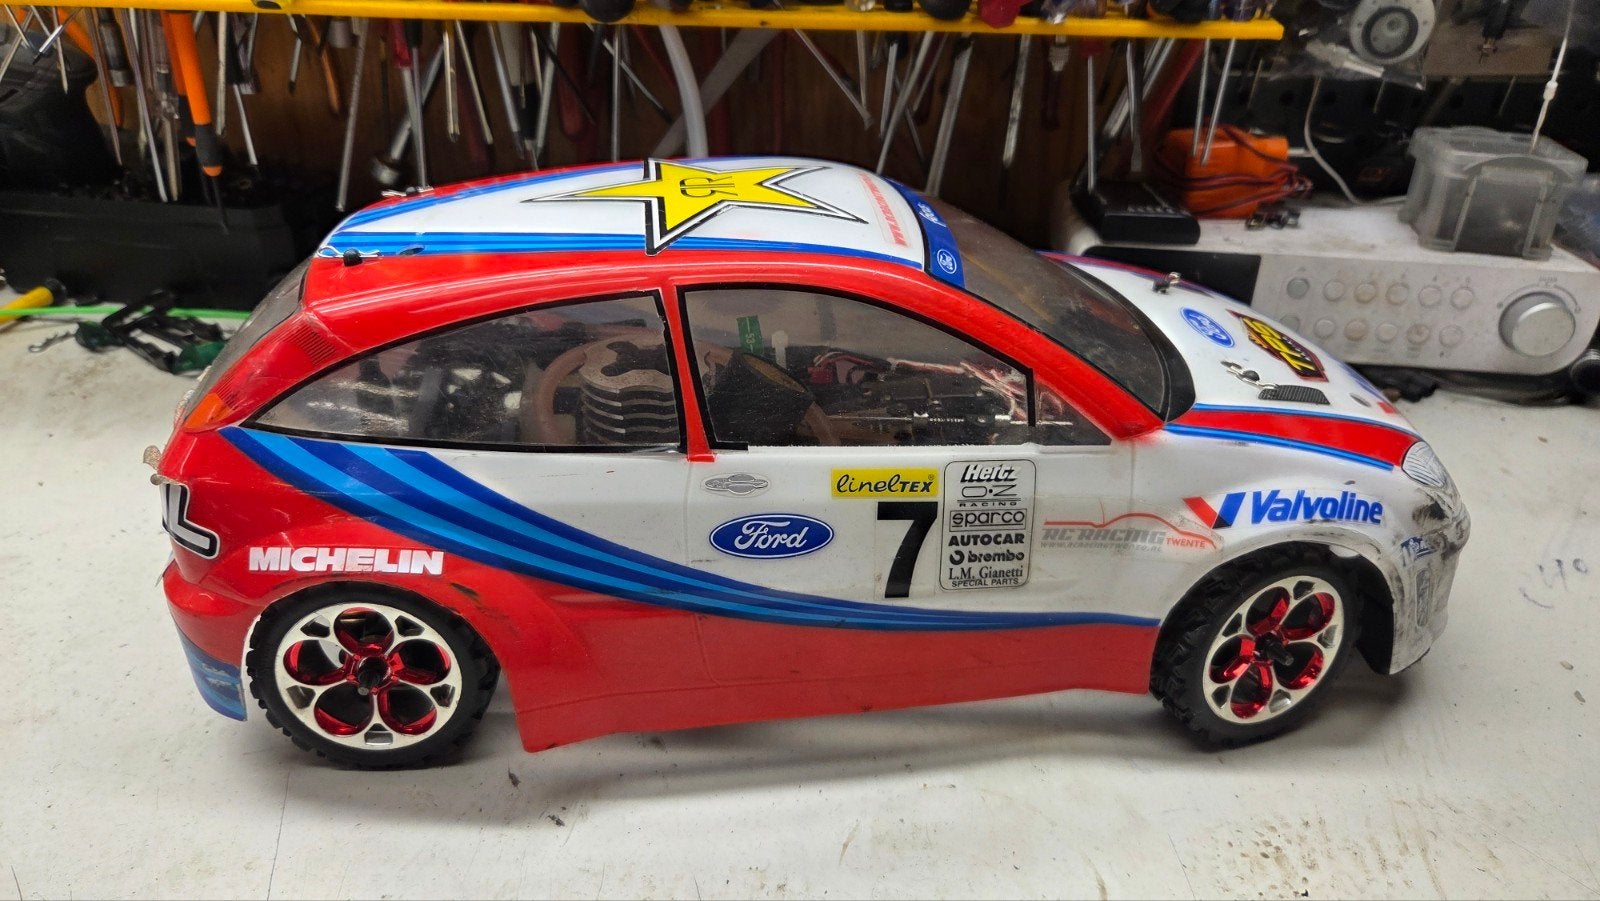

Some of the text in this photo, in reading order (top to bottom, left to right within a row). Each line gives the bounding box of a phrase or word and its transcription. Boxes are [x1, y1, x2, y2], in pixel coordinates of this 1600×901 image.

[960, 463, 1020, 483] Hertz
[1251, 489, 1384, 524] Valvoline
[951, 511, 1025, 527] sparco
[733, 519, 810, 550] Ford
[949, 533, 1025, 547] AUTOCAR
[1078, 528, 1167, 545] RACING
[877, 501, 938, 598] 7
[1166, 537, 1206, 549] TWENTE
[249, 546, 444, 575] MICHELIN
[967, 549, 1025, 563] brembo
[979, 565, 1023, 579] Gianetti
[951, 577, 1019, 588] SPECIAL PARTS
